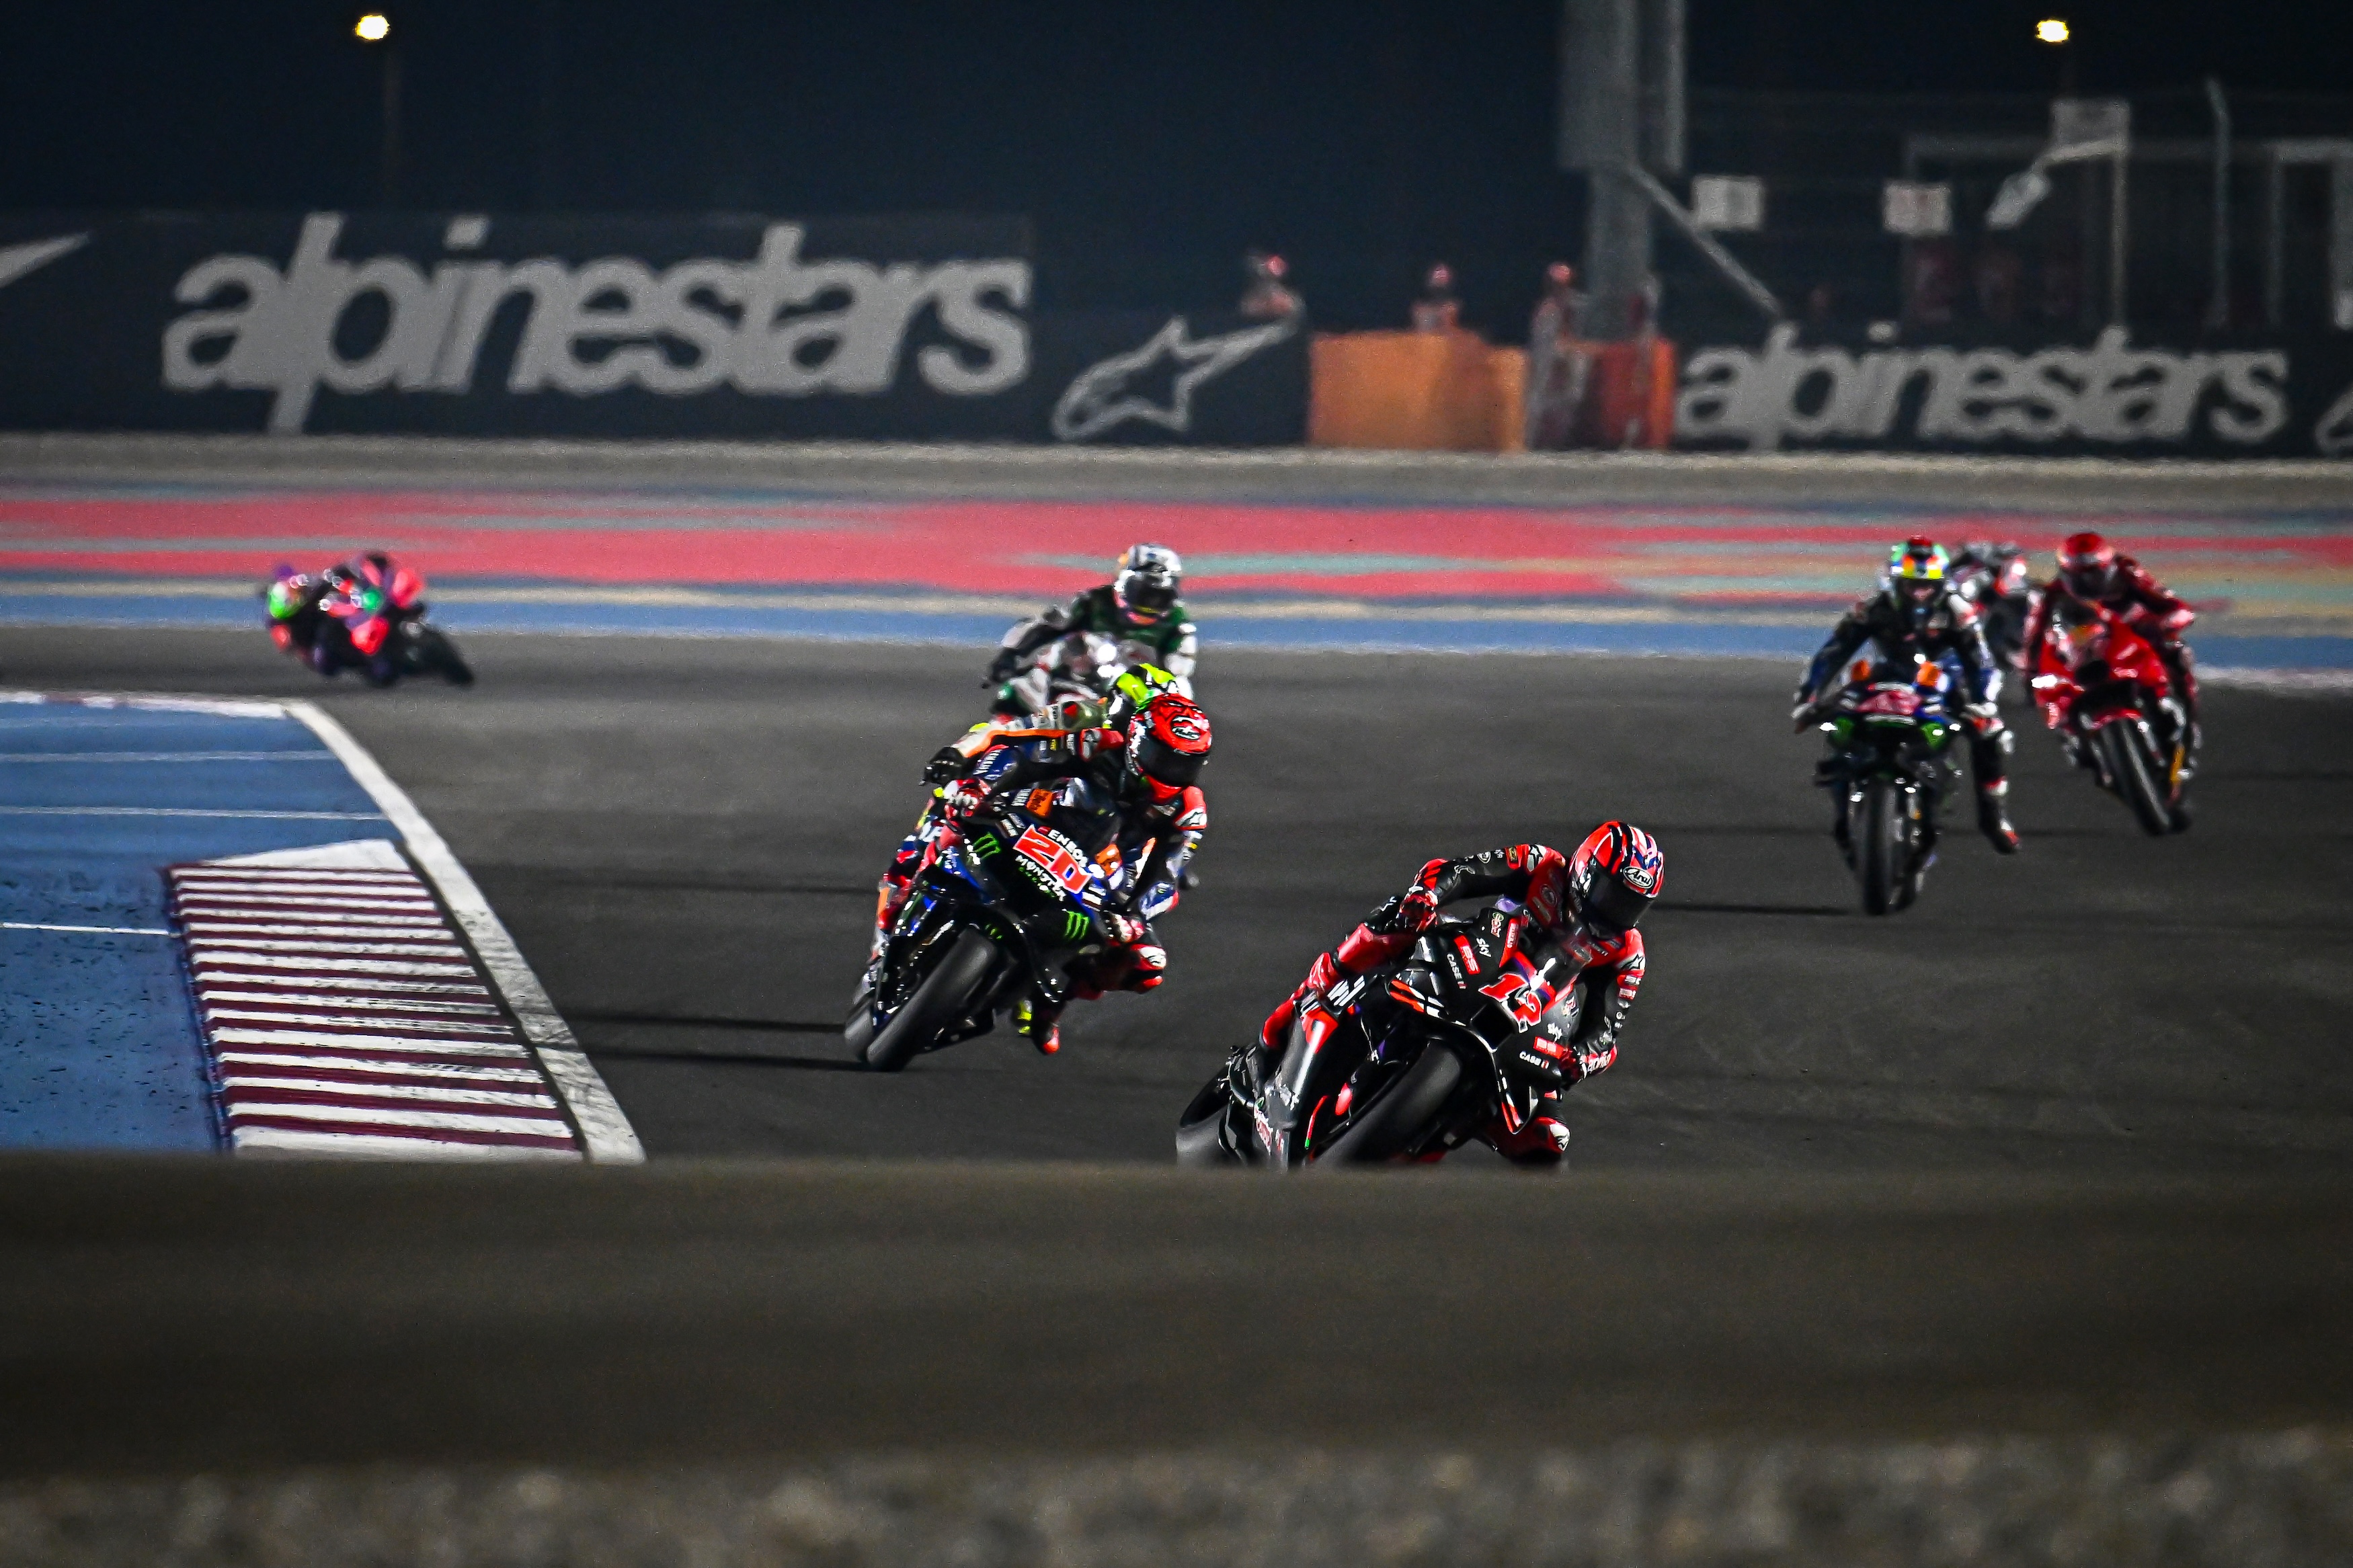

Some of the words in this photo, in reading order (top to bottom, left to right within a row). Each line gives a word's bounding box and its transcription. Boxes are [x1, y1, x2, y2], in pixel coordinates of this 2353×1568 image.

[161, 211, 1033, 434] alpinestars
[1673, 319, 2288, 449] alpinestars
[1012, 823, 1093, 895] 20
[1446, 953, 1463, 980] CASE
[1476, 937, 1492, 958] sky
